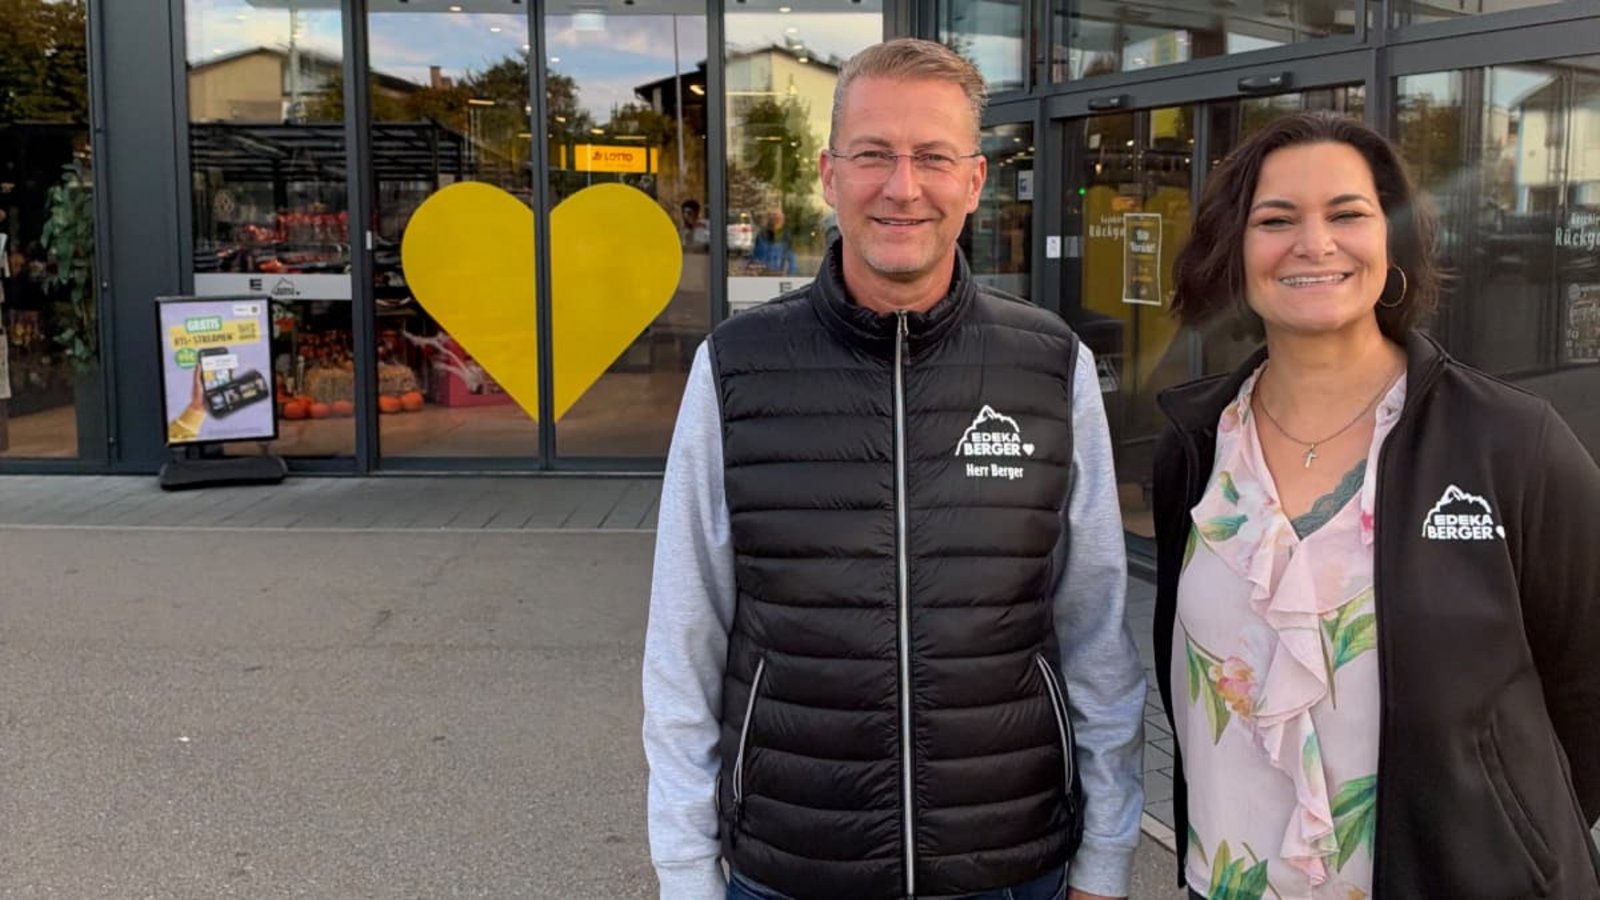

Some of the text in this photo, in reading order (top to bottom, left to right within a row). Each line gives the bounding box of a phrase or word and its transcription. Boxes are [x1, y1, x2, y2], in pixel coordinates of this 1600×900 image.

[604, 152, 634, 162] LOTTO
[971, 432, 1021, 443] EDEKA
[963, 442, 1021, 457] BERGER
[965, 463, 1024, 480] Herr Berger
[1433, 514, 1494, 526] EDEKA
[1427, 525, 1494, 540] BERGER
